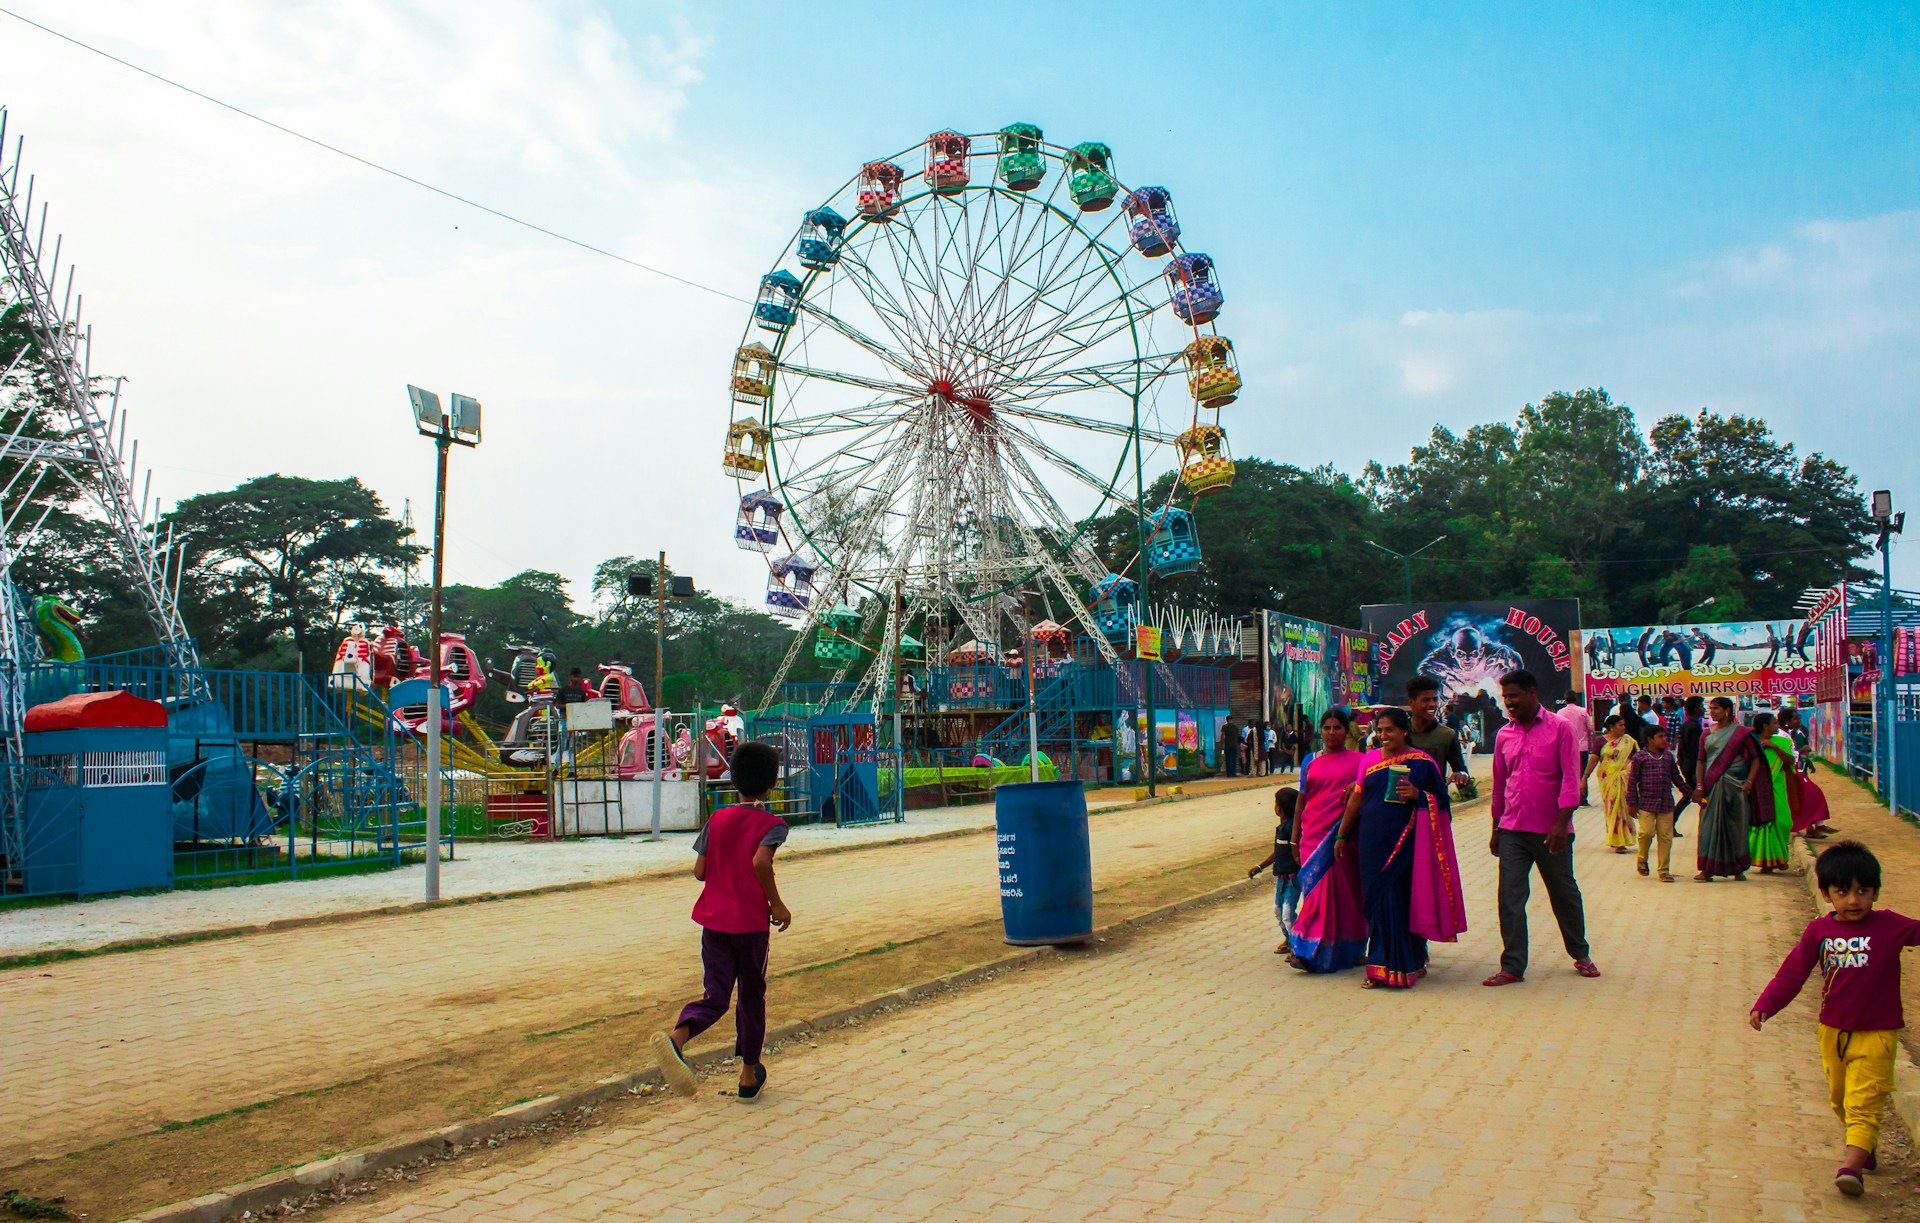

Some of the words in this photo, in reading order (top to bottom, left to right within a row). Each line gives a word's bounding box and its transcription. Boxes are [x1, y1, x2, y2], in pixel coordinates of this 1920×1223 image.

[1380, 610, 1429, 674] SCARY
[1505, 607, 1571, 671] HOUSE
[1591, 682, 1685, 698] LAUGHING
[1690, 679, 1764, 695] MIRROR
[1769, 677, 1818, 693] HOUS
[1825, 936, 1872, 952] ROCK
[1827, 953, 1869, 968] STAR
